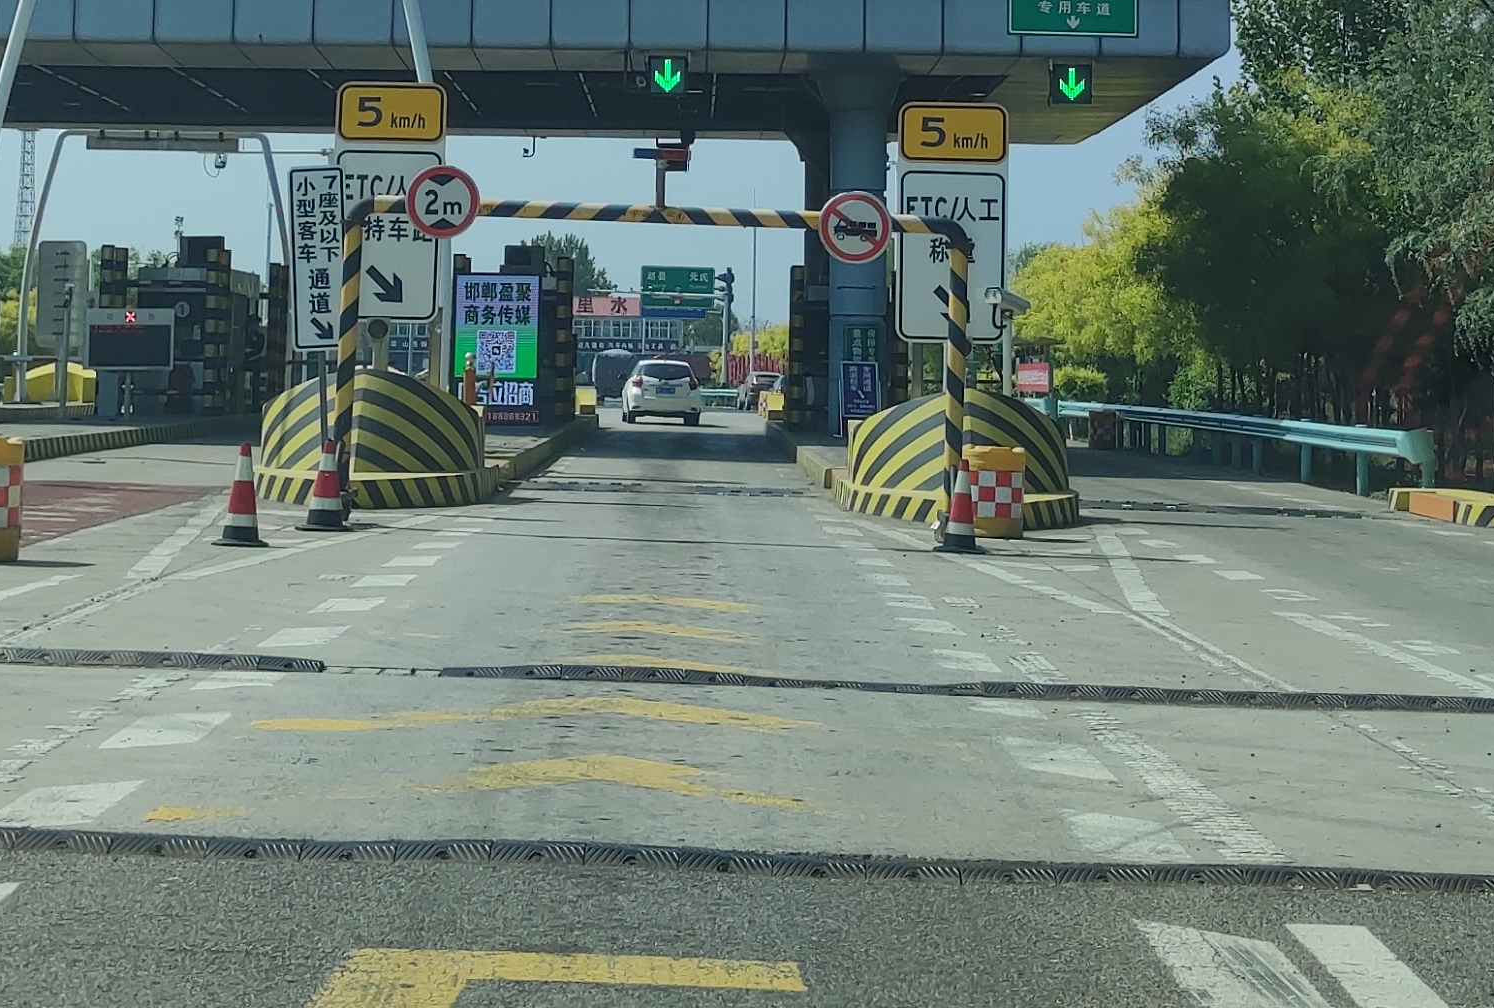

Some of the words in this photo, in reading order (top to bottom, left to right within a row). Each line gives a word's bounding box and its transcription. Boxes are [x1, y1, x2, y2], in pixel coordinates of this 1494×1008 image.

[1037, 0, 1111, 16] 专用车道
[357, 96, 383, 128] 5
[390, 112, 426, 130] km/h
[920, 116, 947, 148] 5
[953, 132, 989, 150] km/h
[345, 174, 408, 201] ETC/人
[424, 189, 463, 216] 2m
[907, 196, 1000, 223] ETC/人工
[296, 176, 318, 264] 小型客车
[318, 174, 342, 263] 7座及以下
[361, 215, 434, 243] 持车
[308, 268, 333, 315] 通道
[464, 281, 532, 303] 邯郸盈聚
[464, 304, 531, 326] 商务传媒
